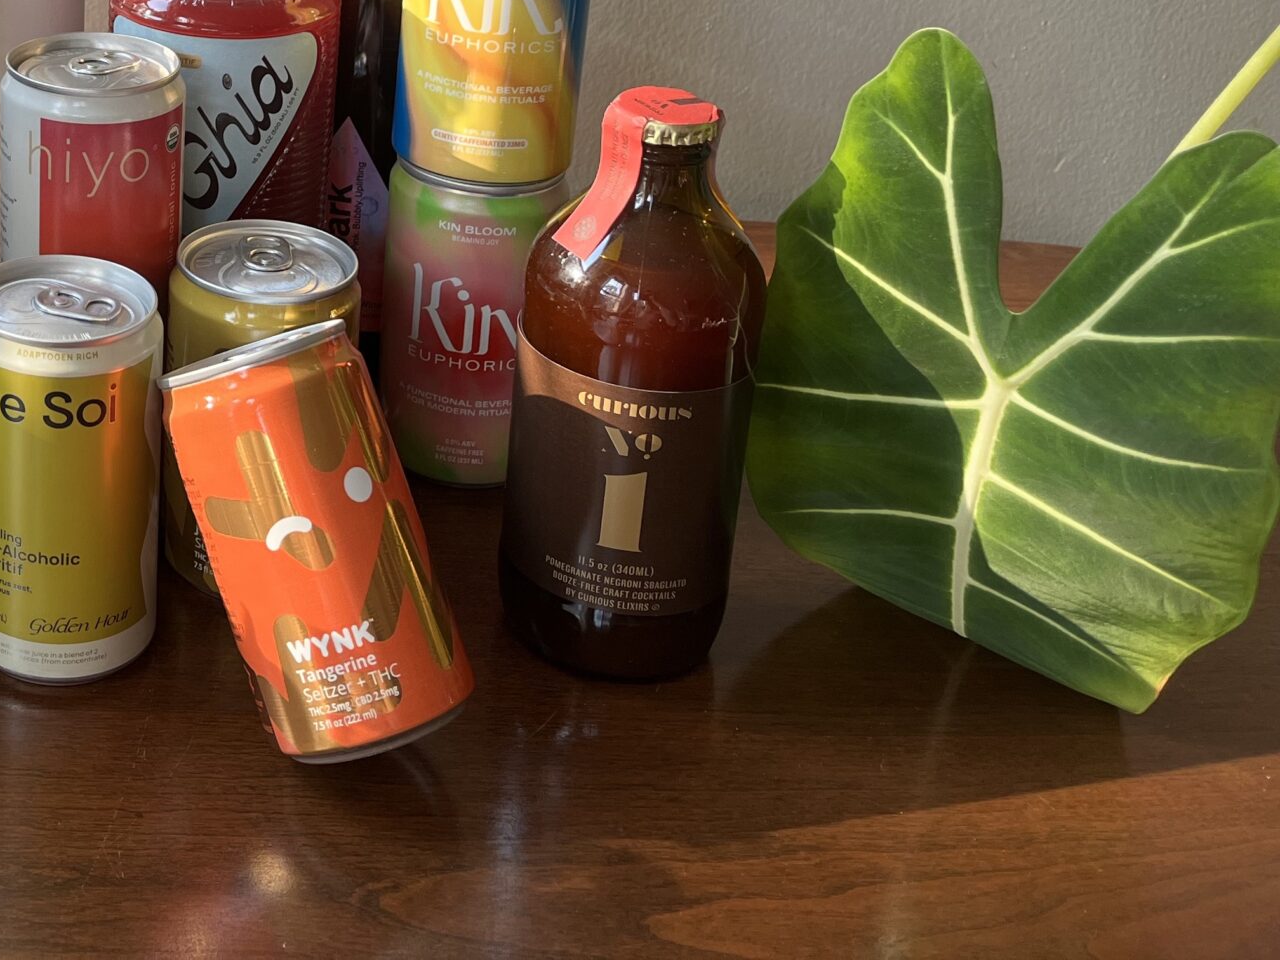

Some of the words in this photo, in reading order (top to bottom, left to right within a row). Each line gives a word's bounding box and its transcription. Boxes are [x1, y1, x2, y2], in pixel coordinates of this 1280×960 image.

[423, 26, 556, 55] EUPHORICS
[423, 82, 445, 95] FOR
[445, 87, 498, 105] MODERN
[499, 94, 546, 105] RITUALS
[425, 71, 494, 94] FUNCTIONAL
[496, 83, 554, 95] BEVERAGE
[182, 55, 296, 211] Ghia
[433, 129, 458, 142] GENTLY
[459, 136, 506, 148] CAFFEINATED
[28, 129, 151, 199] hiyo
[168, 160, 178, 197] tonic
[355, 161, 367, 198] Uplifting
[327, 182, 353, 237] ark
[438, 219, 462, 234] KIN
[464, 225, 517, 237] BLOOM
[451, 234, 486, 246] BEAMING
[486, 237, 501, 246] JOY
[407, 262, 517, 357] Kin
[16, 348, 74, 361] ADAPTOGEN
[76, 350, 99, 361] RICH
[406, 343, 517, 373] EUPHORIC
[42, 382, 117, 430] Soi
[406, 384, 473, 408] FUNCTIONAL
[474, 399, 511, 408] BEVER
[426, 400, 476, 417] MODERN
[477, 407, 511, 418] RITUA
[577, 391, 693, 421] curious
[545, 554, 601, 583] POMEGRANATE
[603, 575, 642, 590] NEGRONI
[643, 578, 688, 590] SBAGLIATO
[578, 555, 596, 569] 11.5
[596, 562, 609, 572] oz
[611, 562, 655, 578] (340ML)
[552, 569, 601, 595] BOOZE-FREE
[602, 583, 630, 600] CRAFT
[631, 590, 677, 601] COCKTAILS
[565, 586, 576, 599] BY
[577, 592, 615, 609] CURIOUS
[616, 598, 650, 612] ELIXIRS
[27, 616, 90, 636] Golden
[94, 606, 132, 630] Hour
[64, 650, 85, 659] blend
[286, 619, 375, 664] WYNK
[41, 657, 61, 665] (from
[62, 653, 108, 665] concentrate)
[295, 653, 378, 684] Tangerine
[302, 680, 353, 704] Seltzer
[367, 662, 402, 686] THC
[308, 705, 325, 718] THC
[325, 700, 353, 716] 2.5mg
[354, 693, 372, 708] CBD
[373, 684, 400, 702] 2.5mg
